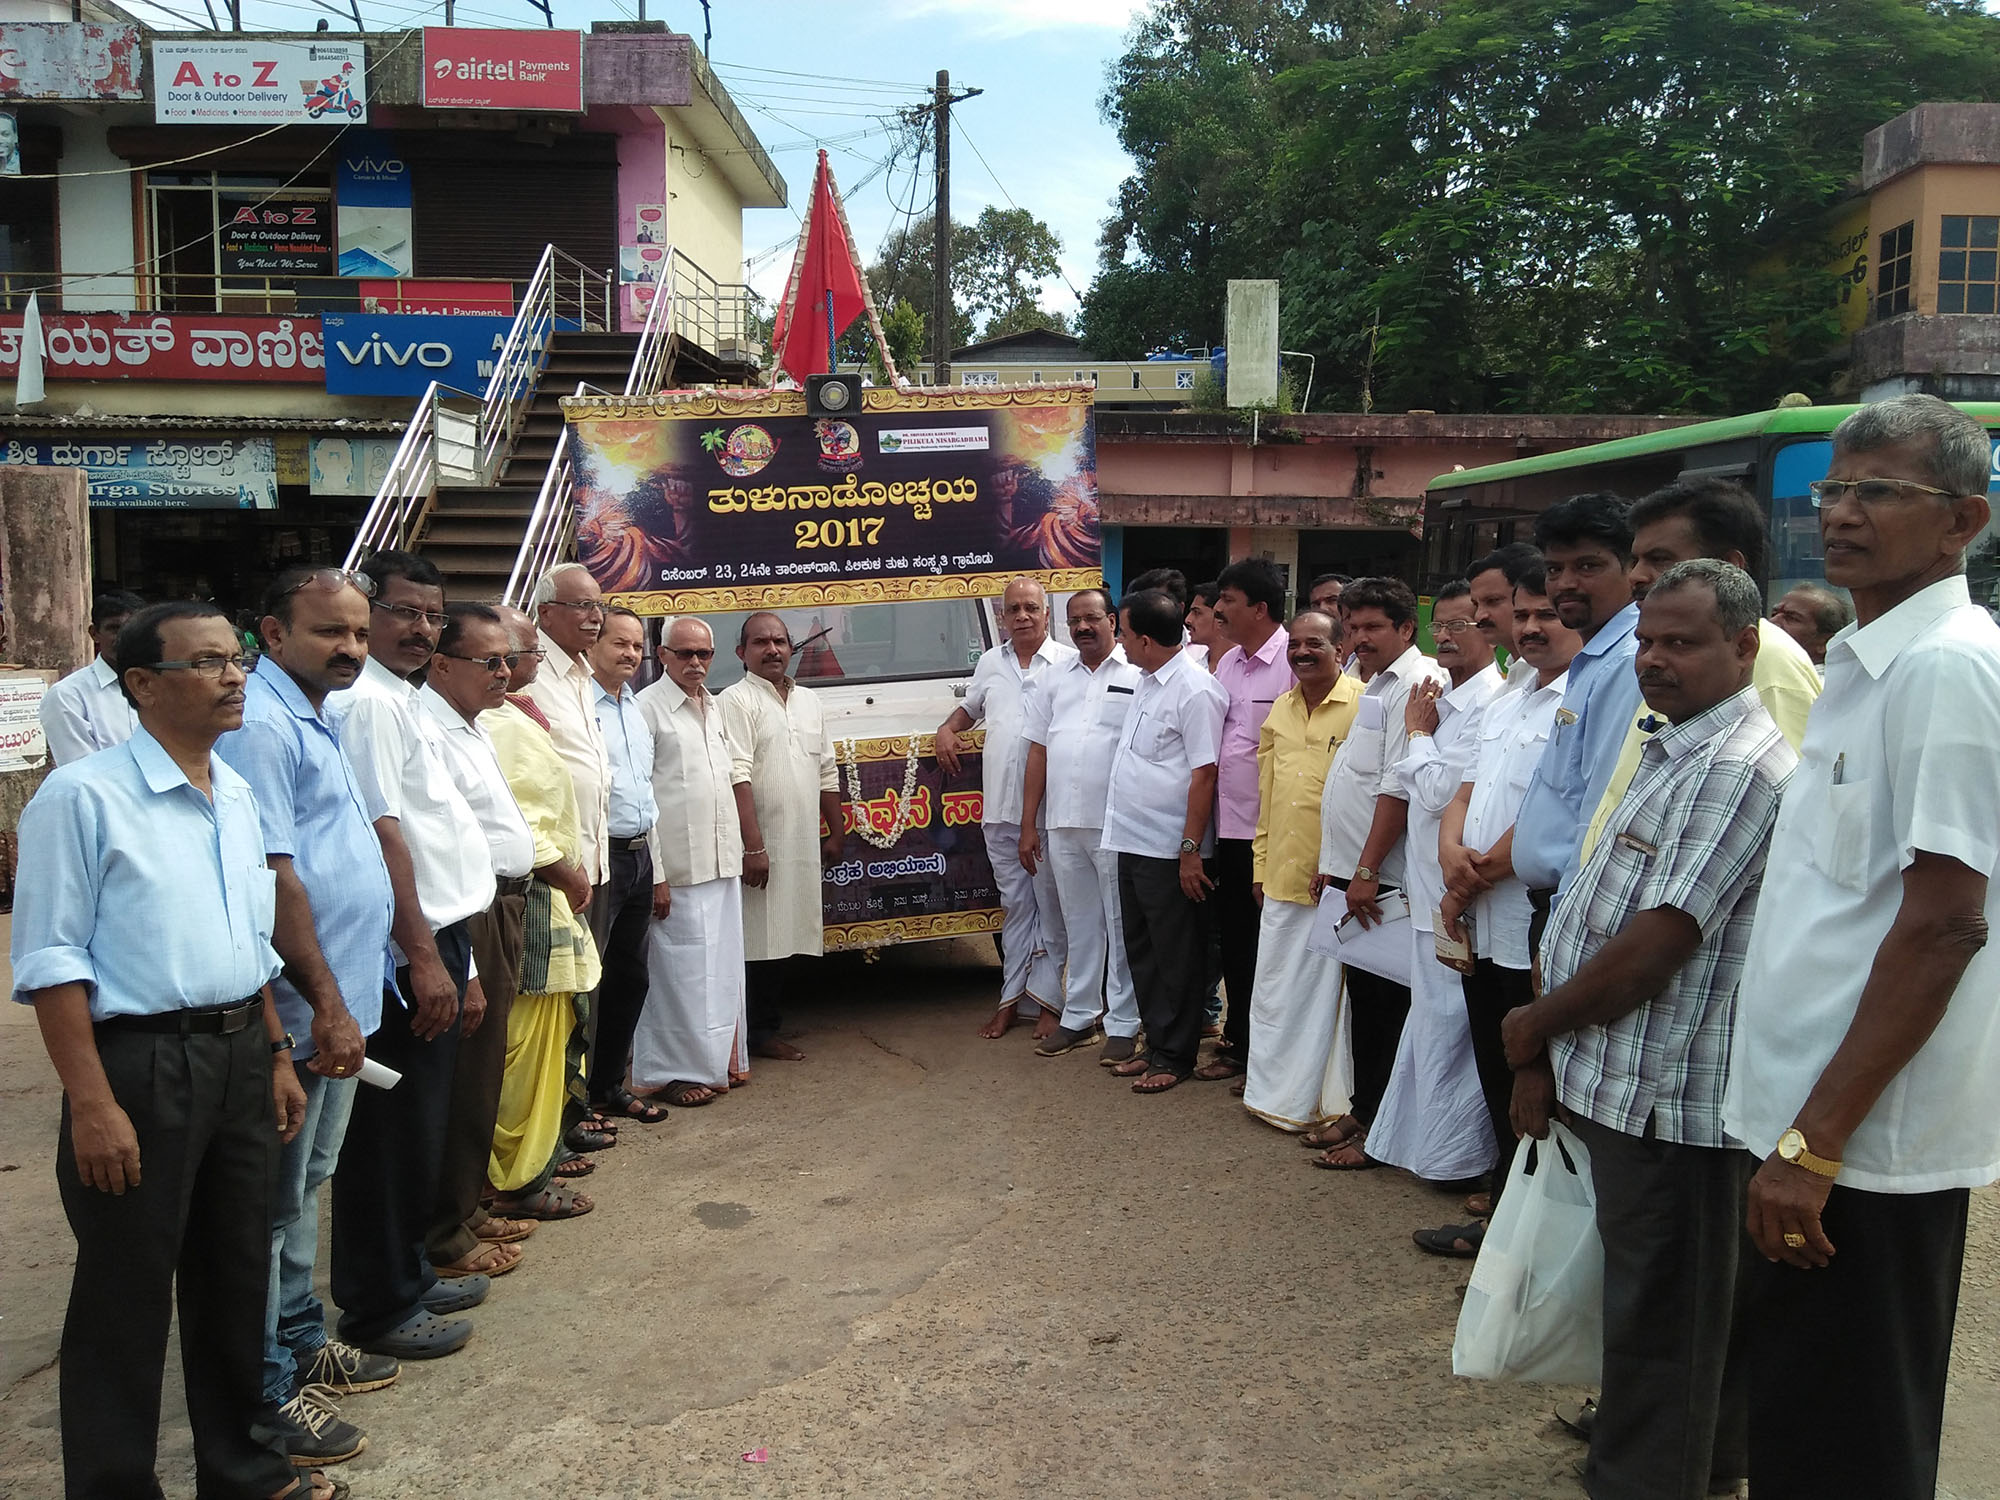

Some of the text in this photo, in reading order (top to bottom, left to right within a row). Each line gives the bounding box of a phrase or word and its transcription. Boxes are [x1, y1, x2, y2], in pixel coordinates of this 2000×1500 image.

[172, 61, 278, 87] A to Z
[456, 56, 570, 80] airtel Payments
[519, 71, 546, 82] Bank
[168, 91, 288, 103] Door & Outdoor Delivery
[239, 109, 257, 117] Home
[347, 156, 404, 173] vivo
[234, 207, 316, 224] A to Z
[231, 231, 249, 240] Door
[259, 231, 289, 241] Outdoor
[336, 332, 453, 367] vivo
[936, 436, 987, 444] NISARGADHAMA
[149, 482, 237, 496] Stores
[707, 473, 978, 521] ತುಳುನಾಡೋಚ್ಚಯ
[119, 499, 162, 507] available
[165, 499, 190, 507] here.
[795, 516, 885, 549] 2017
[715, 564, 737, 581] 23,
[740, 563, 771, 579] 24ನೇ
